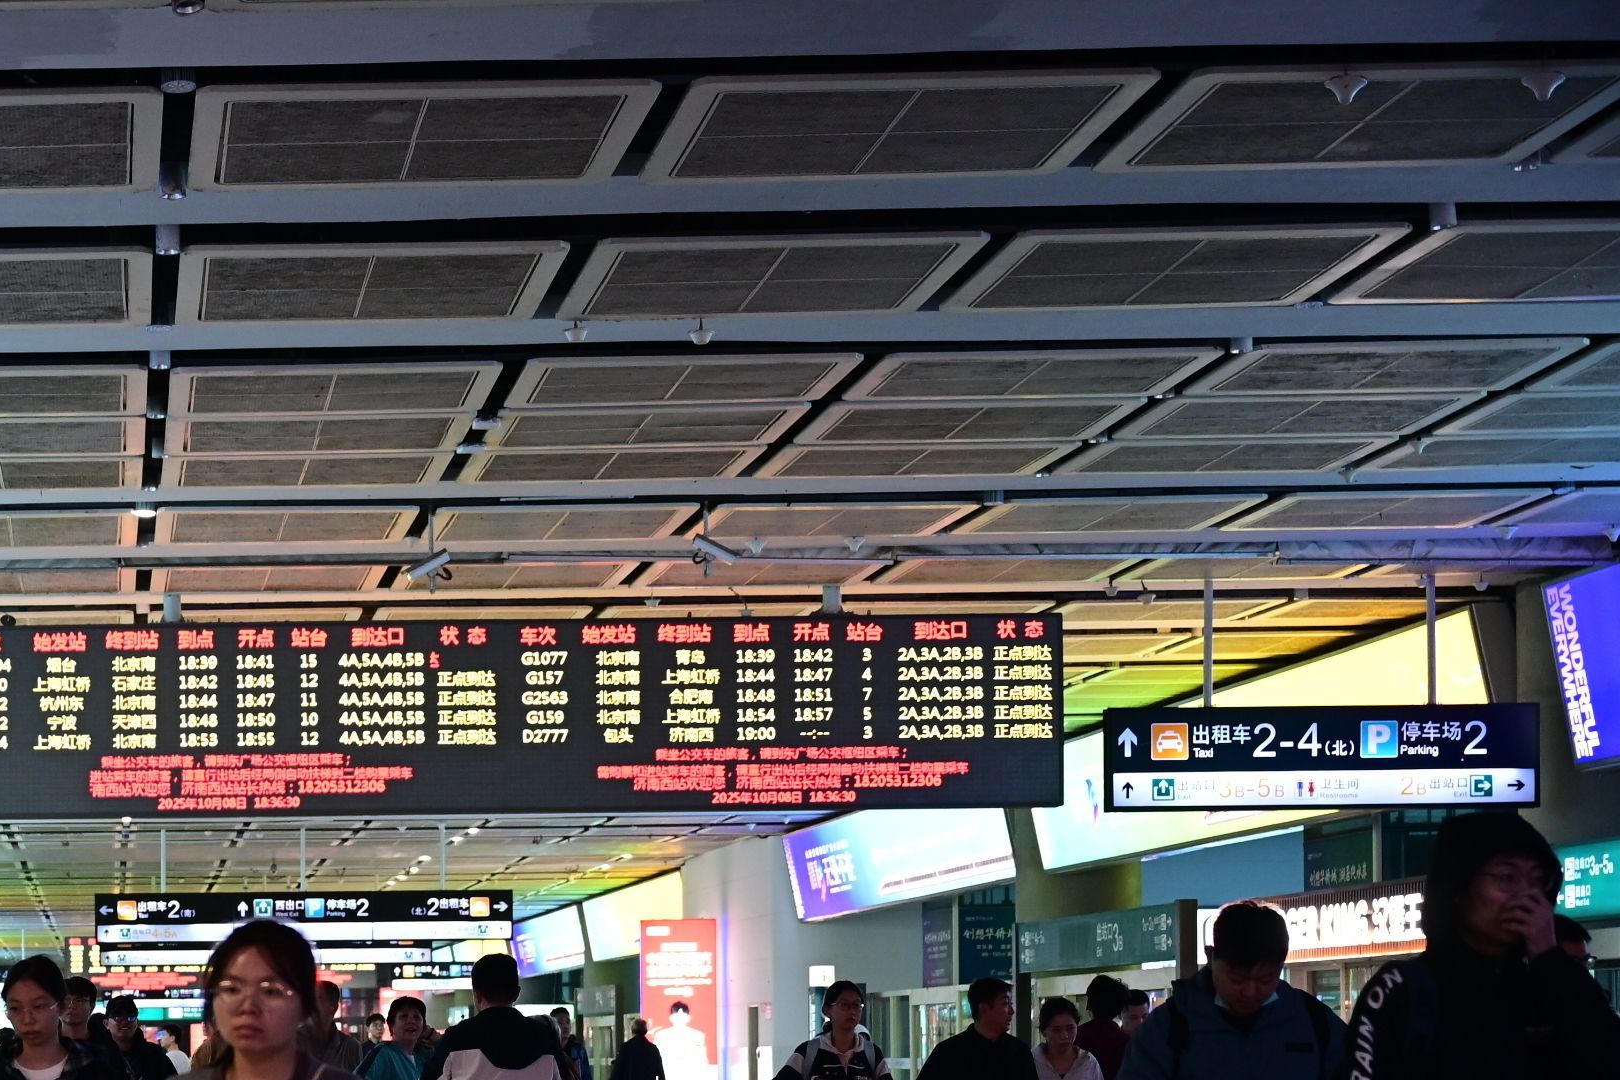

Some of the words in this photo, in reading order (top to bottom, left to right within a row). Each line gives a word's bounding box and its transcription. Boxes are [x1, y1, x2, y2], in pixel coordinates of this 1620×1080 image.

[33, 632, 87, 652] 始发站
[105, 630, 159, 650] 终到站
[178, 629, 214, 650] 到点
[238, 628, 274, 648] 开点
[291, 628, 327, 648] 站台
[351, 627, 404, 647] 到达口
[520, 626, 556, 646] 车次
[582, 624, 636, 644] 始发站
[657, 624, 712, 643] 终到站
[734, 623, 769, 642] 到点
[794, 622, 830, 641] 开点
[846, 622, 883, 641] 站台
[914, 621, 967, 640] 到达口
[46, 657, 76, 673] 烟台
[112, 656, 156, 672] 北京南
[179, 655, 217, 670] 18:39
[236, 655, 274, 669] 18:41
[300, 654, 317, 668] 15
[521, 651, 568, 665] G1077
[596, 650, 640, 666] 北京南
[676, 649, 705, 665] 青岛
[736, 649, 775, 663] 18:39
[794, 648, 832, 662] 18:42
[862, 648, 872, 661] 3
[993, 644, 1052, 660] 正点到达
[526, 671, 564, 685] G157
[596, 669, 640, 685] 北京南
[661, 668, 720, 684] 上海虹桥
[737, 669, 775, 682] 18:44
[794, 668, 832, 682] 18:47
[862, 667, 872, 680] 4
[993, 664, 1052, 680] 正点到达
[1546, 587, 1589, 760] EVERYWHERE
[1559, 583, 1600, 757] WONDERFUL
[33, 676, 90, 692] 上海虹桥
[112, 675, 156, 692] 石家庄
[179, 675, 218, 689] 18:42
[237, 674, 274, 688] 18:45
[301, 674, 318, 687] 12
[437, 670, 496, 687] 正点到达
[40, 695, 84, 711] 杭州东
[112, 694, 156, 711] 北京南
[179, 694, 218, 708] 18:44
[237, 693, 275, 707] 18:47
[301, 693, 317, 707] 11
[437, 690, 496, 706] 正点到达
[522, 691, 568, 705] G2563
[596, 690, 640, 705] 北京南
[669, 688, 713, 704] 合肥南
[737, 689, 775, 702] 18:48
[795, 688, 832, 702] 18:51
[863, 687, 872, 700] 7
[993, 684, 1052, 700] 正点到达
[47, 714, 77, 730] 宁波
[112, 714, 156, 730] 天津西
[180, 713, 218, 728] 18:48
[237, 713, 275, 727] 18:50
[301, 712, 318, 726] 10
[438, 709, 496, 725] 正点到达
[526, 710, 564, 724] G159
[596, 709, 640, 725] 北京南
[662, 708, 720, 724] 上海虹桥
[737, 708, 775, 722] 18:54
[795, 707, 833, 721] 18:57
[863, 707, 872, 720] 5
[994, 704, 1052, 719] 正点到达
[33, 733, 91, 750] 上海虹桥
[113, 733, 156, 749] 北京南
[180, 733, 218, 747] 18:53
[237, 732, 275, 746] 18:55
[301, 732, 319, 745] 12
[437, 728, 496, 745] 正点到达
[523, 729, 568, 743] D2777
[604, 727, 634, 743] 包头
[669, 727, 714, 742] 济南西
[737, 727, 776, 740] 19:00
[863, 726, 872, 739] 3
[994, 722, 1053, 738] 正点到达
[1193, 724, 1251, 745] 出租车
[1401, 721, 1462, 741] 停车场
[1464, 720, 1487, 755] 2
[1193, 748, 1214, 758] Taxi
[1400, 745, 1439, 757] Parking
[634, 778, 726, 791] 济南西站欢迎您
[1321, 778, 1359, 790] 卫生间
[1401, 776, 1427, 796] 2B
[1430, 777, 1468, 789] 出站口
[157, 797, 247, 810] 2025年10月08日
[254, 796, 300, 809] 18:36:30
[712, 790, 802, 804] 2025年10月08日
[809, 790, 856, 802] 18:36:30
[138, 901, 167, 913] 出租车
[168, 900, 181, 918] 2
[275, 900, 304, 911] 西出口
[327, 899, 356, 910] 停车场
[357, 898, 369, 917] 2
[427, 897, 440, 916] 2
[440, 898, 469, 909] 出租车
[1320, 900, 1368, 944] KING
